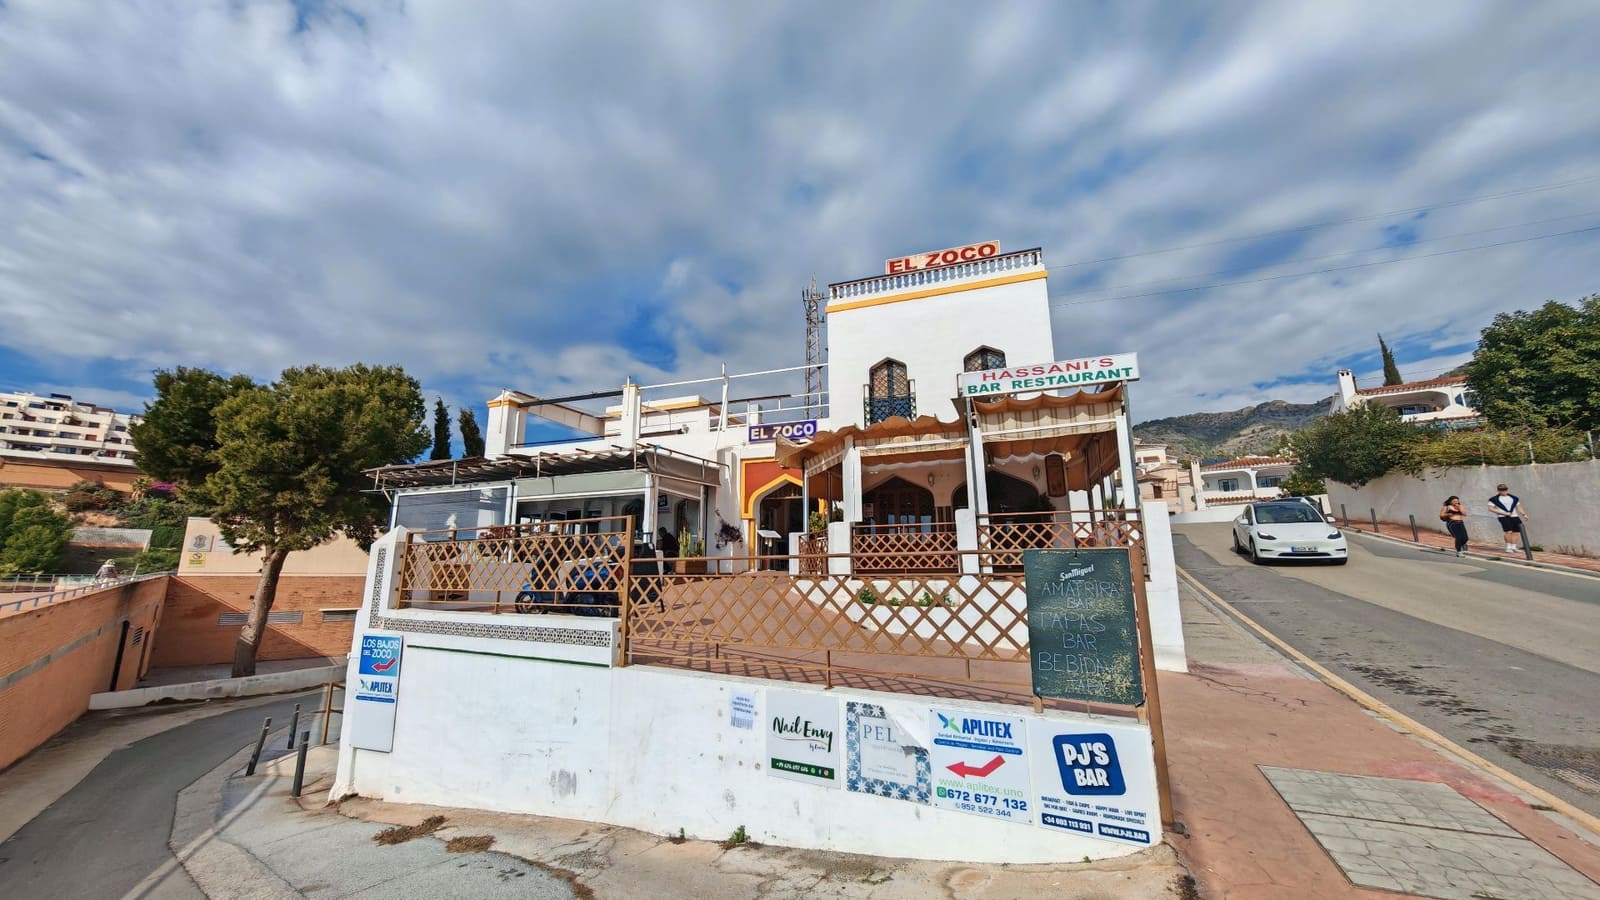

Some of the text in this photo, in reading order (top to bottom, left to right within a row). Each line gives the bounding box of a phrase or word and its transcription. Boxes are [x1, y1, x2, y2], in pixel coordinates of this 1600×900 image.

[889, 244, 996, 274] EL ZOCO
[982, 357, 1114, 381] HASSANI'S
[967, 367, 1133, 394] BAR RESTAURANT
[751, 423, 815, 440] EL ZOCO
[1040, 611, 1106, 632] TAPAS
[363, 639, 399, 649] LOS BAJOS
[1063, 633, 1097, 651] BAR
[372, 649, 392, 658] ZOCO
[370, 681, 392, 693] APLITEX
[773, 716, 802, 734] Nail
[803, 721, 833, 753] Envy
[962, 718, 1013, 739] APLITEX
[1062, 742, 1110, 766] PJ'S
[1074, 767, 1110, 787] BAR
[938, 778, 1024, 798] www.aplitex.uno
[947, 789, 1028, 811] 672 677 132
[995, 808, 1012, 817] 344
